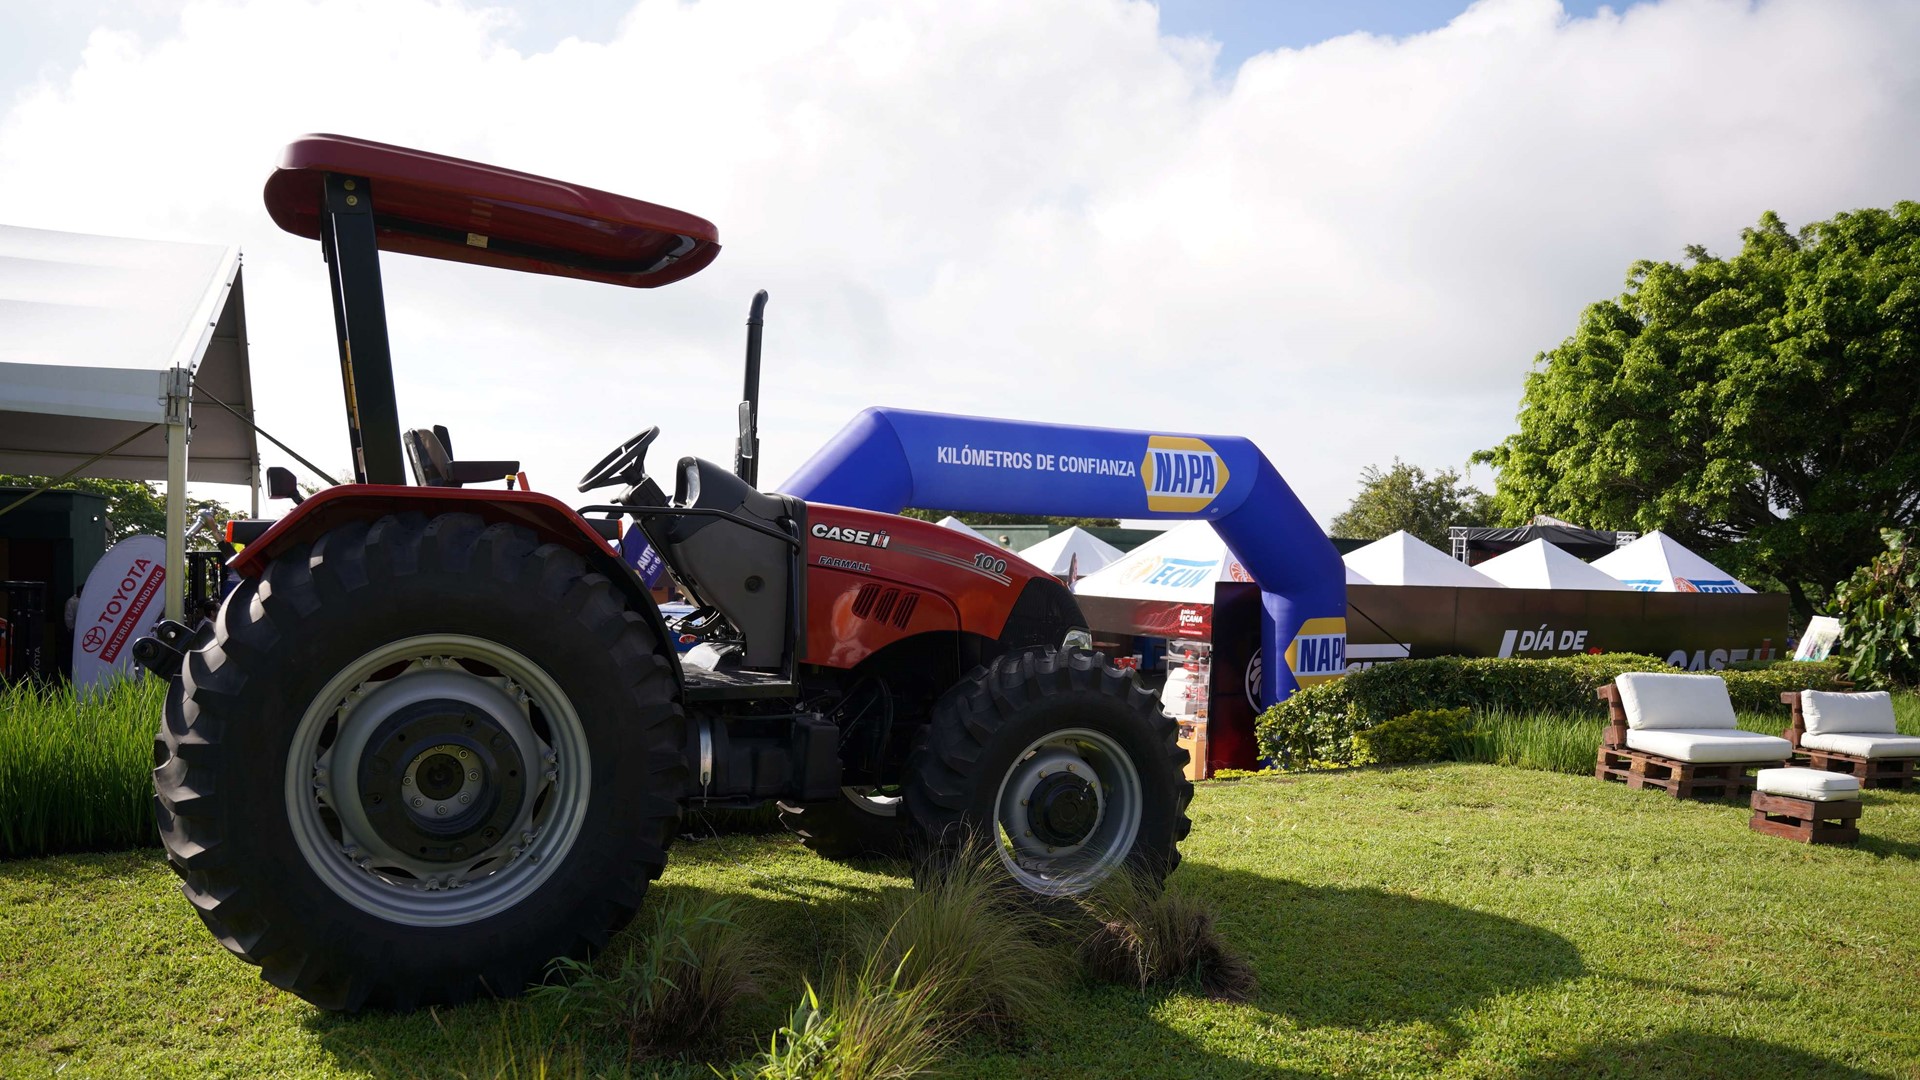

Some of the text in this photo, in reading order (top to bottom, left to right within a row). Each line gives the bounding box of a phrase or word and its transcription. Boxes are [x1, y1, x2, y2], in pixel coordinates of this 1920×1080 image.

[937, 444, 1136, 477] KILÓMETROS DE CONFIANZA
[1154, 452, 1215, 494] NAPA
[811, 523, 870, 545] CASE
[819, 555, 871, 572] FARMALL
[974, 552, 1007, 574] 100
[98, 558, 151, 624] TOYOTA
[105, 570, 163, 659] MATERIAL HANDLING
[1518, 623, 1588, 651] DÍA DE
[1300, 637, 1346, 672] NAPA
